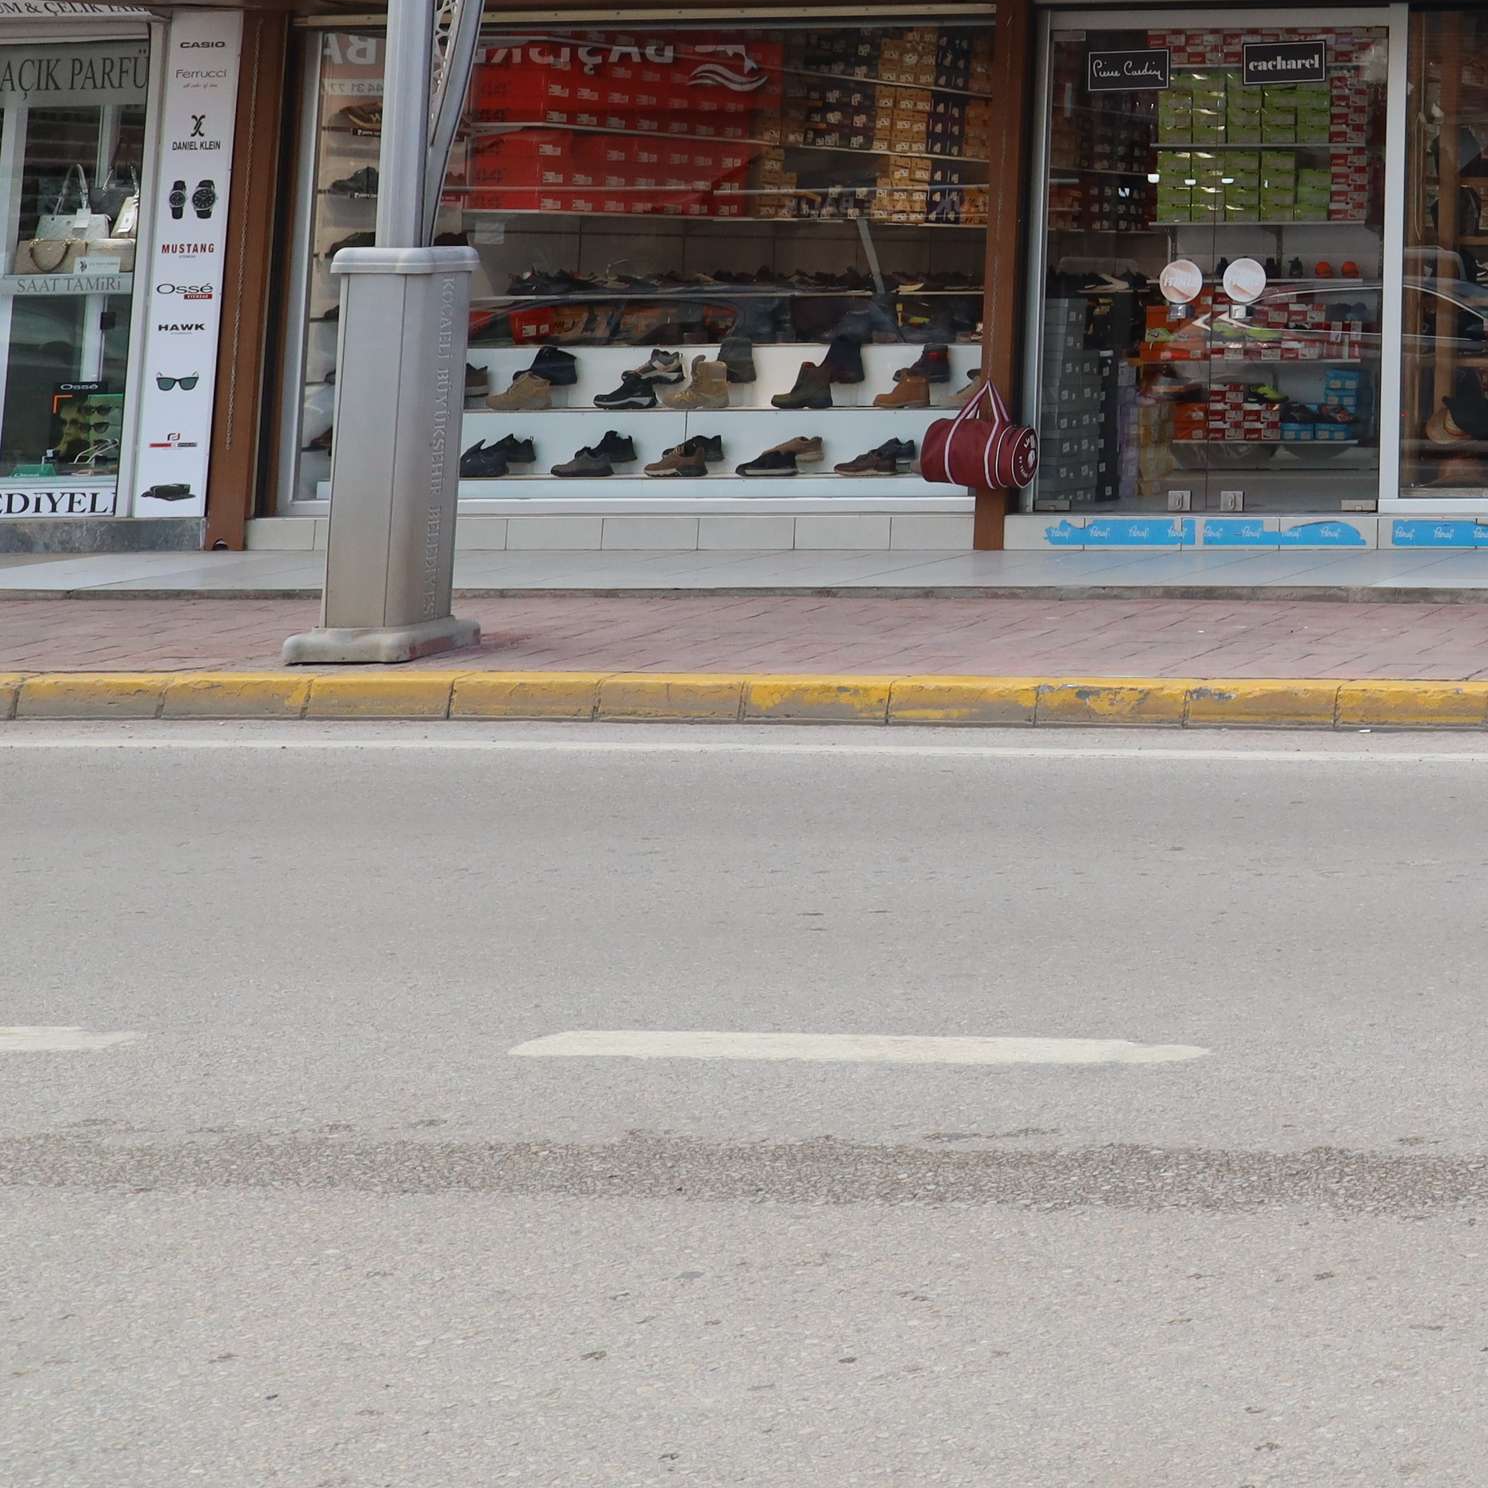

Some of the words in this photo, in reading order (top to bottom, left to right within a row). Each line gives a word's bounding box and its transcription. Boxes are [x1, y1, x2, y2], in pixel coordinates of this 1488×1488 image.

[180, 41, 226, 49] CASIO
[1248, 53, 1320, 73] cacharel
[0, 59, 62, 100] AÇIK
[175, 69, 227, 79] Ferrucci
[172, 141, 198, 151] DANIEL
[199, 140, 221, 151] KLEIN
[161, 243, 216, 254] MUSTANG
[17, 277, 60, 294] SAAT
[156, 282, 214, 295] Ossé
[158, 323, 206, 332] HAWK
